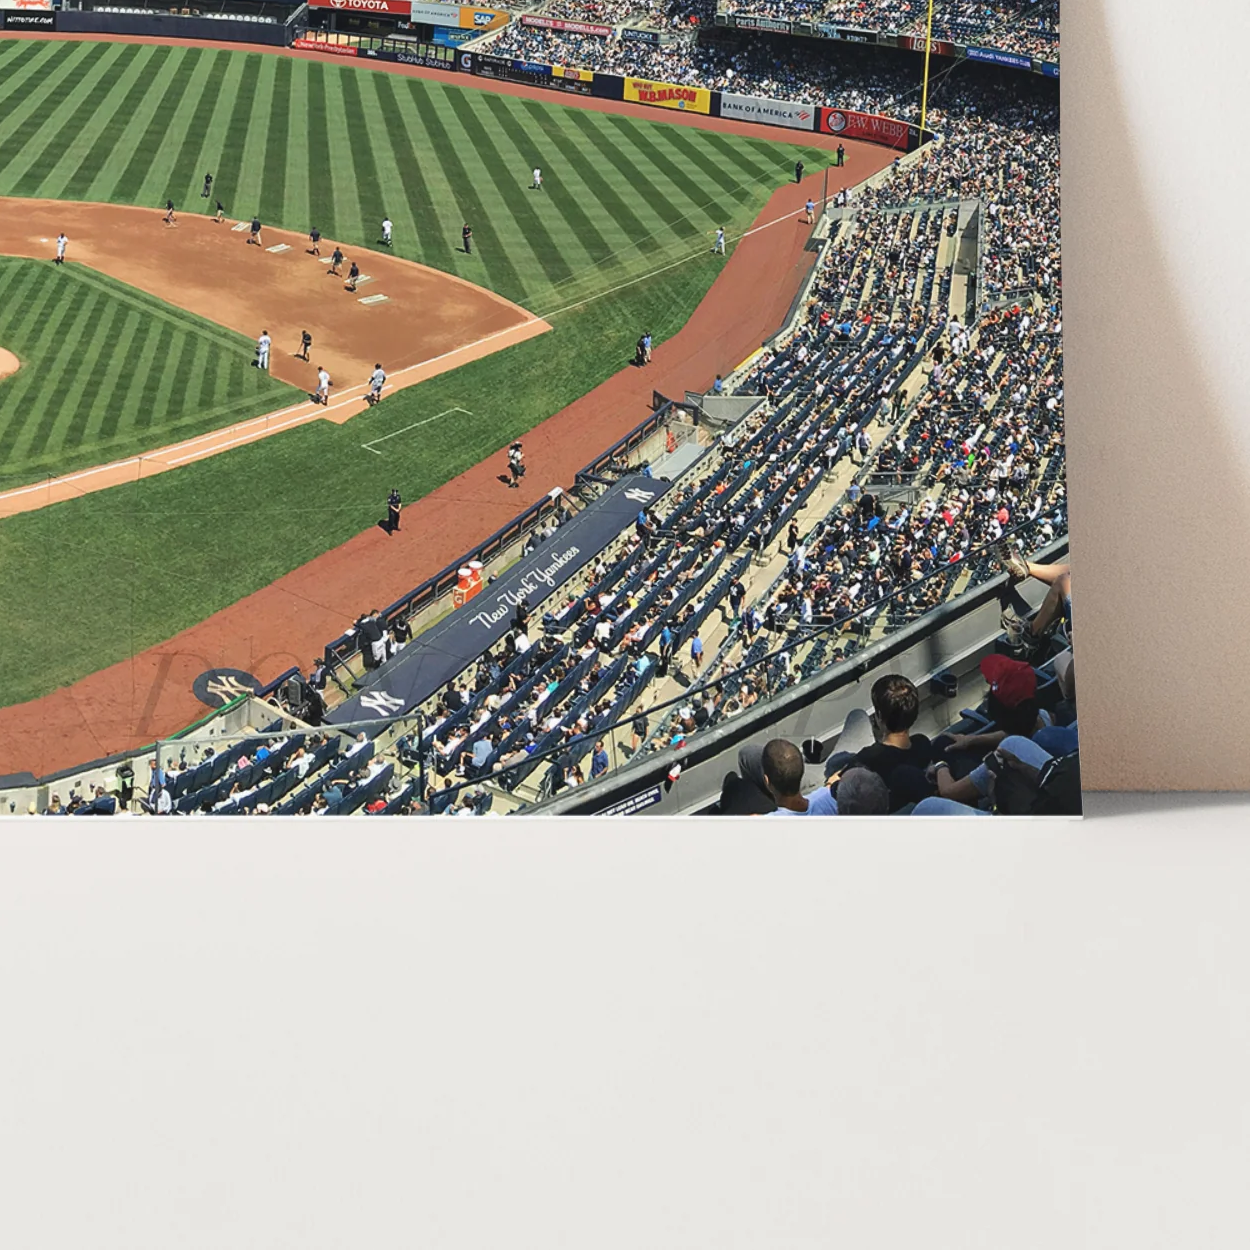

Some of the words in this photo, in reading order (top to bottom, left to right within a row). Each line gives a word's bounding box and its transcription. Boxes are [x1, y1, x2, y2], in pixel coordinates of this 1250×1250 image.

[475, 15, 492, 24] SAP
[396, 53, 424, 65] StubHub
[425, 57, 451, 69] StubHub
[461, 53, 472, 68] G
[980, 52, 995, 60] Audi
[722, 102, 744, 111] BANK
[757, 107, 794, 119] AMERICA
[847, 115, 869, 130] F.W.
[870, 119, 904, 138] WEBB
[468, 603, 509, 630] New
[496, 577, 539, 607] York
[525, 546, 580, 587] Yankees
